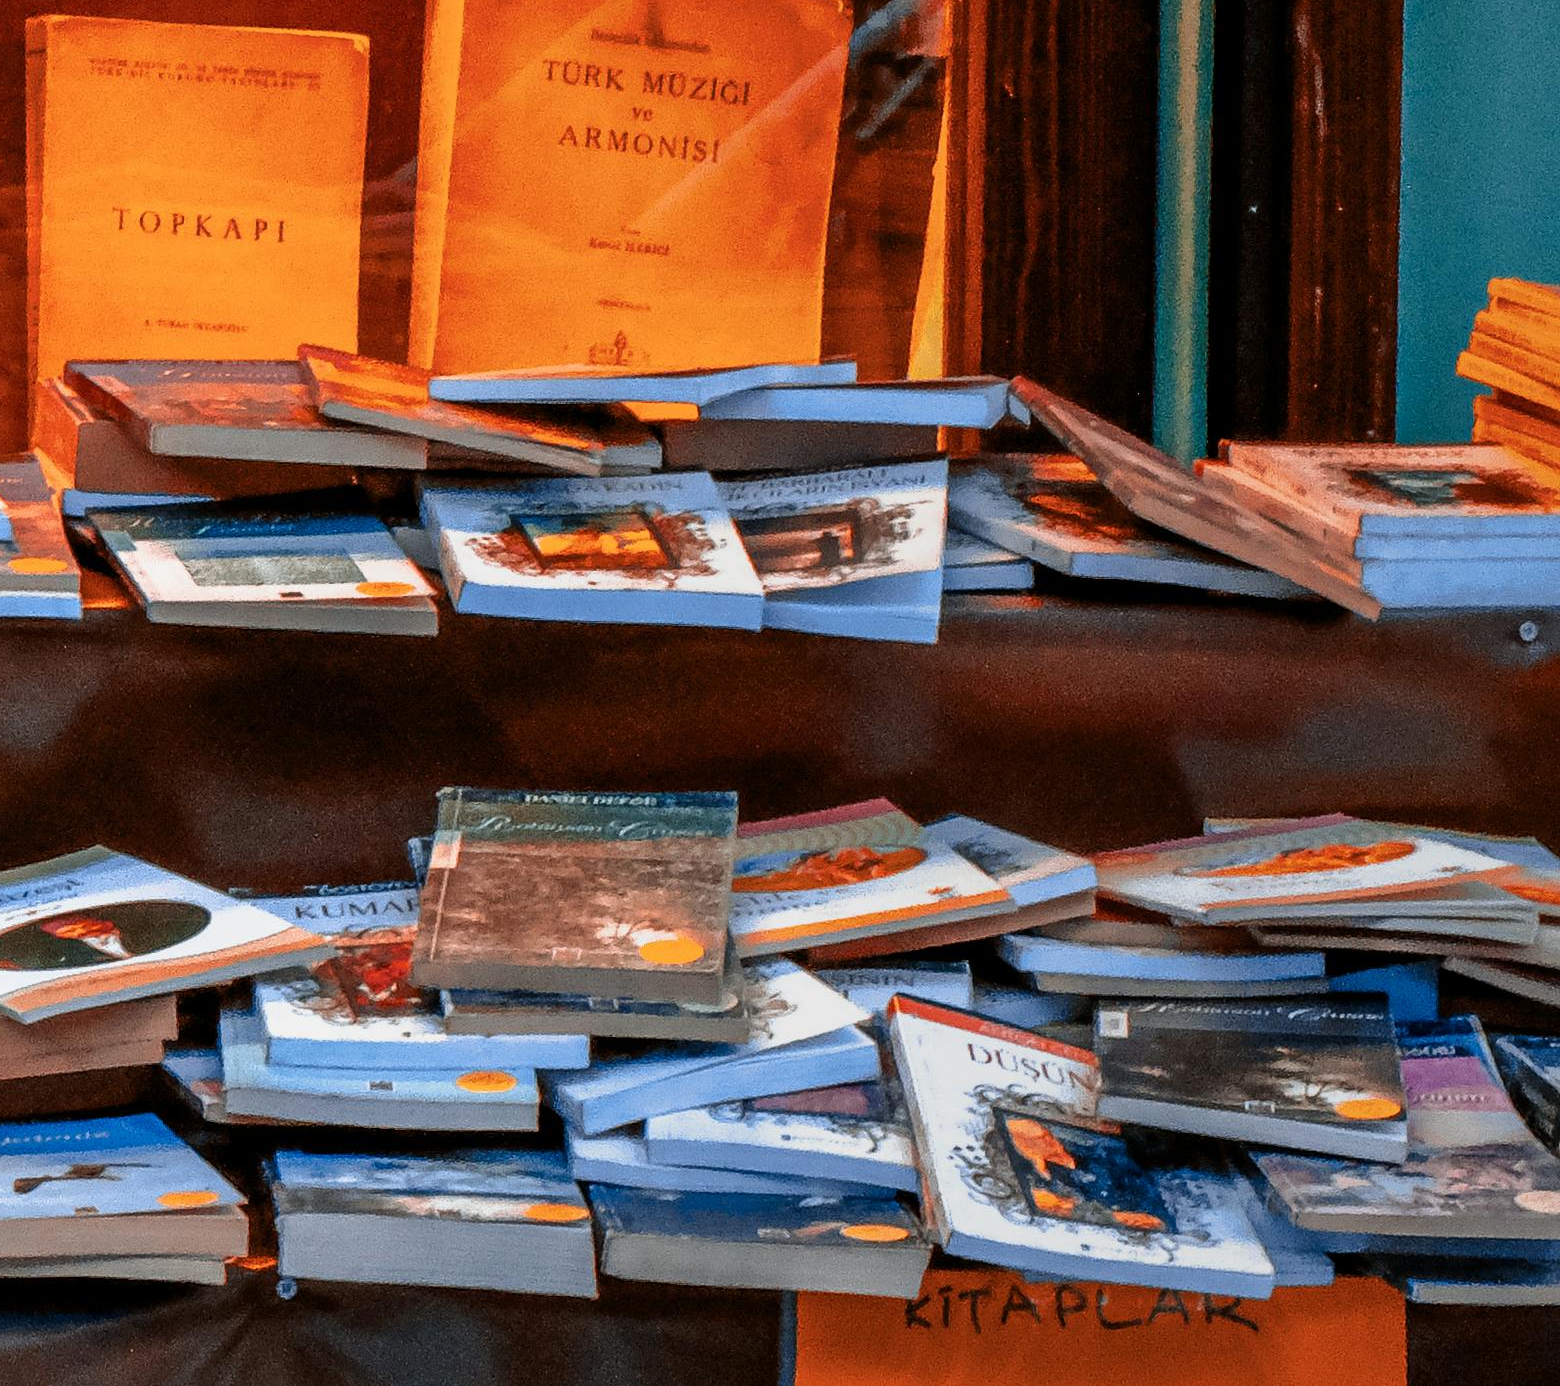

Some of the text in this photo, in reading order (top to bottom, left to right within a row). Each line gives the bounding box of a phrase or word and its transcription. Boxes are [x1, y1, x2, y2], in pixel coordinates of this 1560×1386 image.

[543, 58, 624, 92] TÜRK
[632, 106, 654, 122] ve
[557, 123, 720, 164] ARMONİSİ
[112, 207, 286, 243] TOPKAPI
